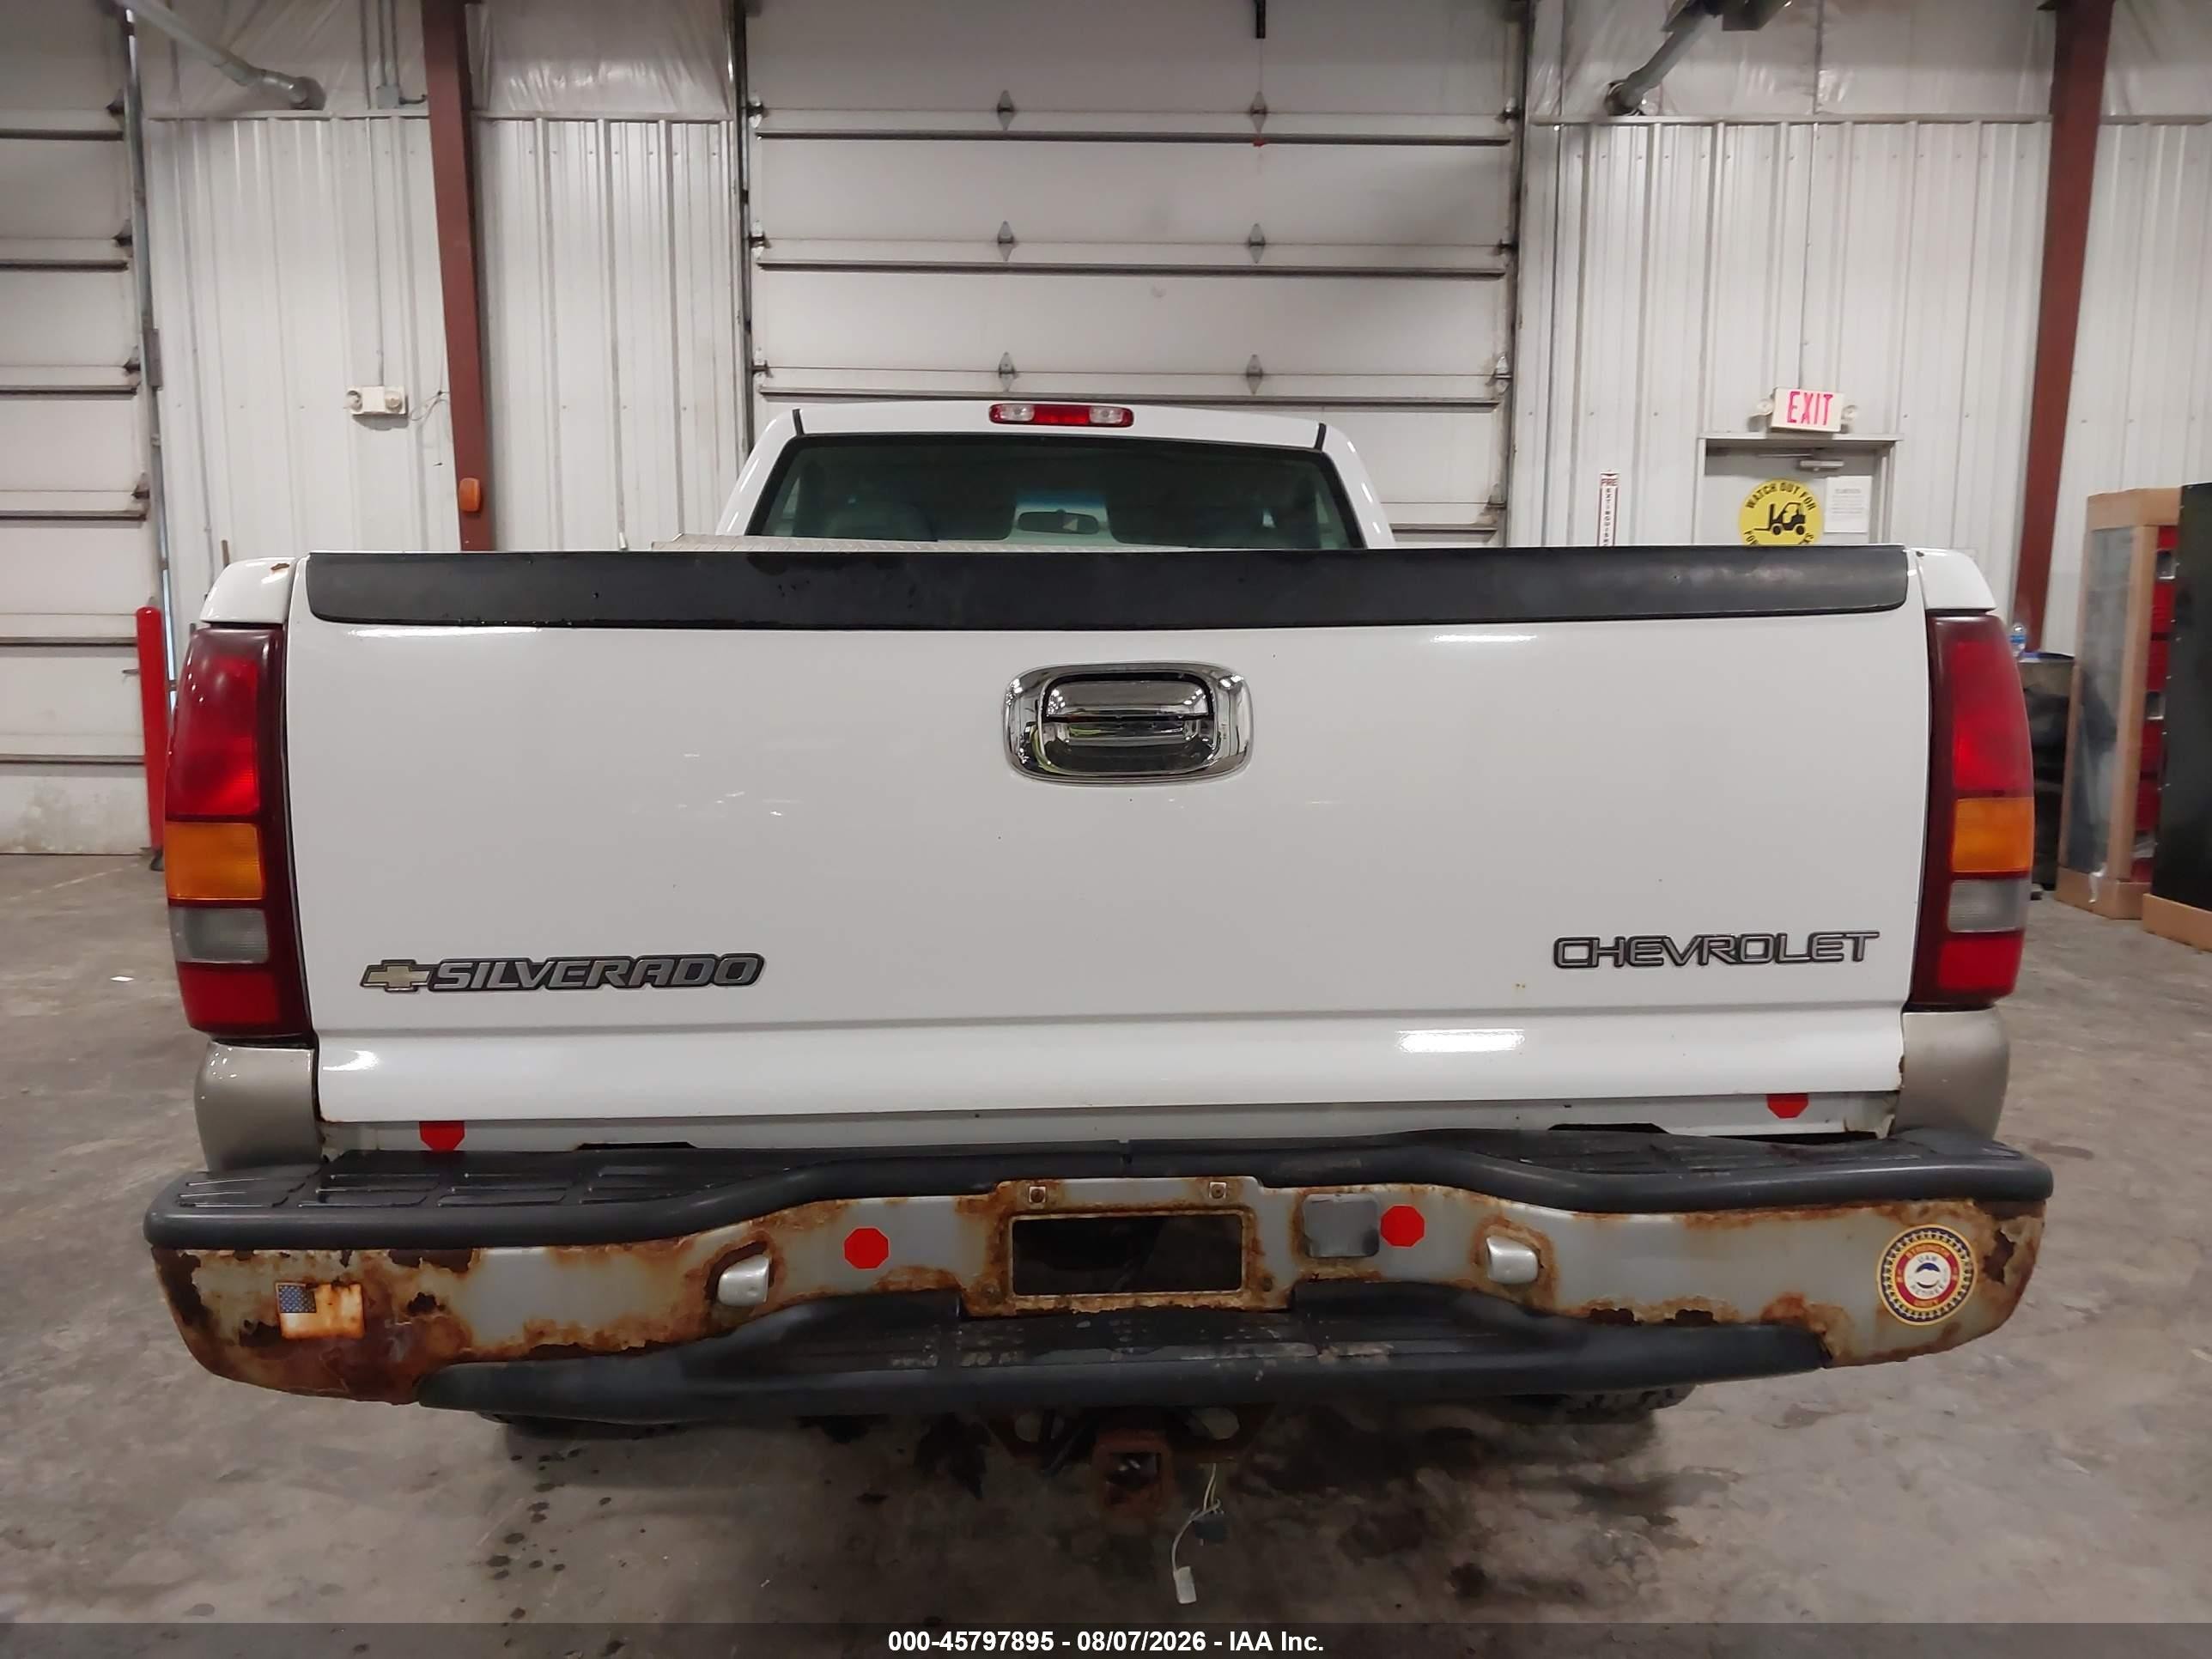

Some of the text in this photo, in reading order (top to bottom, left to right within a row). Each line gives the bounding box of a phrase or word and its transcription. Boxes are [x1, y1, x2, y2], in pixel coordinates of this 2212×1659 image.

[1787, 392, 1832, 425] EXIT
[1745, 483, 1778, 508] WATCH
[1779, 482, 1800, 495] OUT
[1799, 491, 1816, 511] FOR
[1553, 931, 1881, 969] CHEVROLET
[431, 954, 764, 991] SILVERADO
